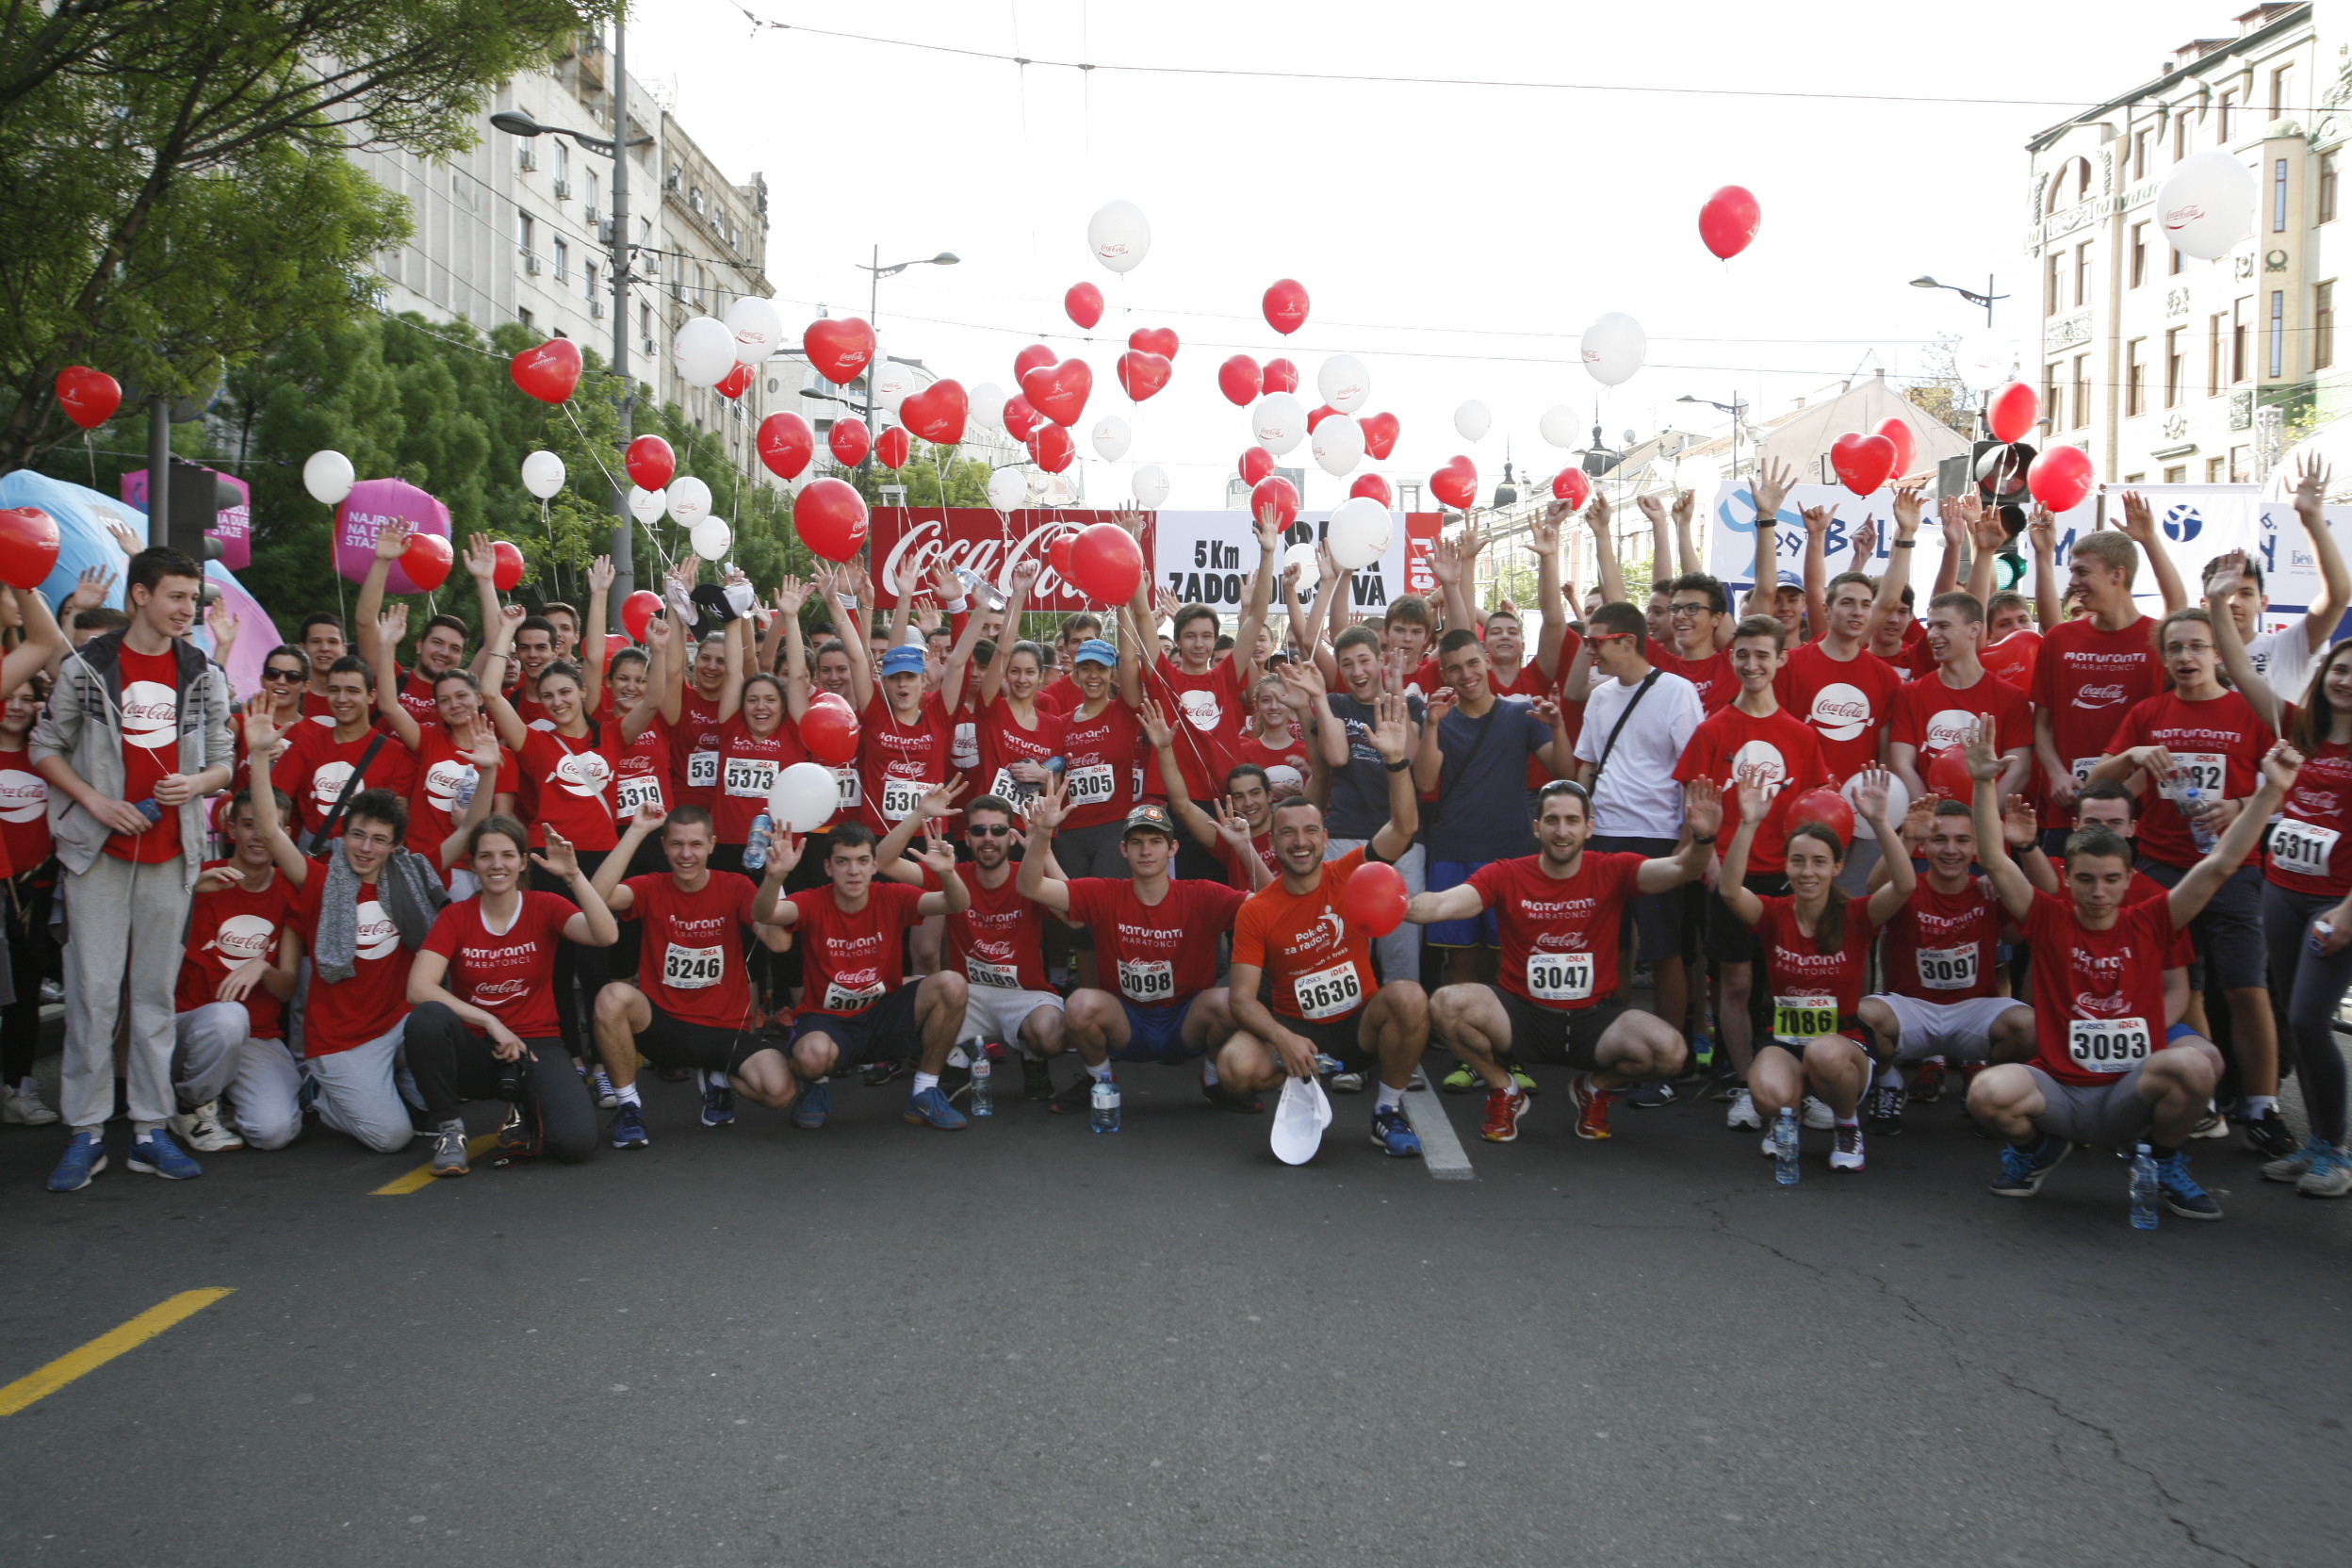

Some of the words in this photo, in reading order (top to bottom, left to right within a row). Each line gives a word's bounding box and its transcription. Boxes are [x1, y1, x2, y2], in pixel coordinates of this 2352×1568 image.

[882, 520, 1091, 597] Coca-Co
[727, 768, 774, 791] 5373
[1069, 775, 1113, 797] 5305
[885, 792, 922, 811] 530
[2275, 831, 2326, 865] 5311
[667, 956, 720, 979] 3246
[969, 967, 1019, 988] 3089
[1532, 966, 1588, 989] 3047
[1921, 954, 1977, 981] 3097
[1120, 970, 1171, 993] 3098
[1299, 974, 1358, 1011] 3636
[1778, 1010, 1832, 1035] 1086
[2074, 1032, 2147, 1061] 3093
